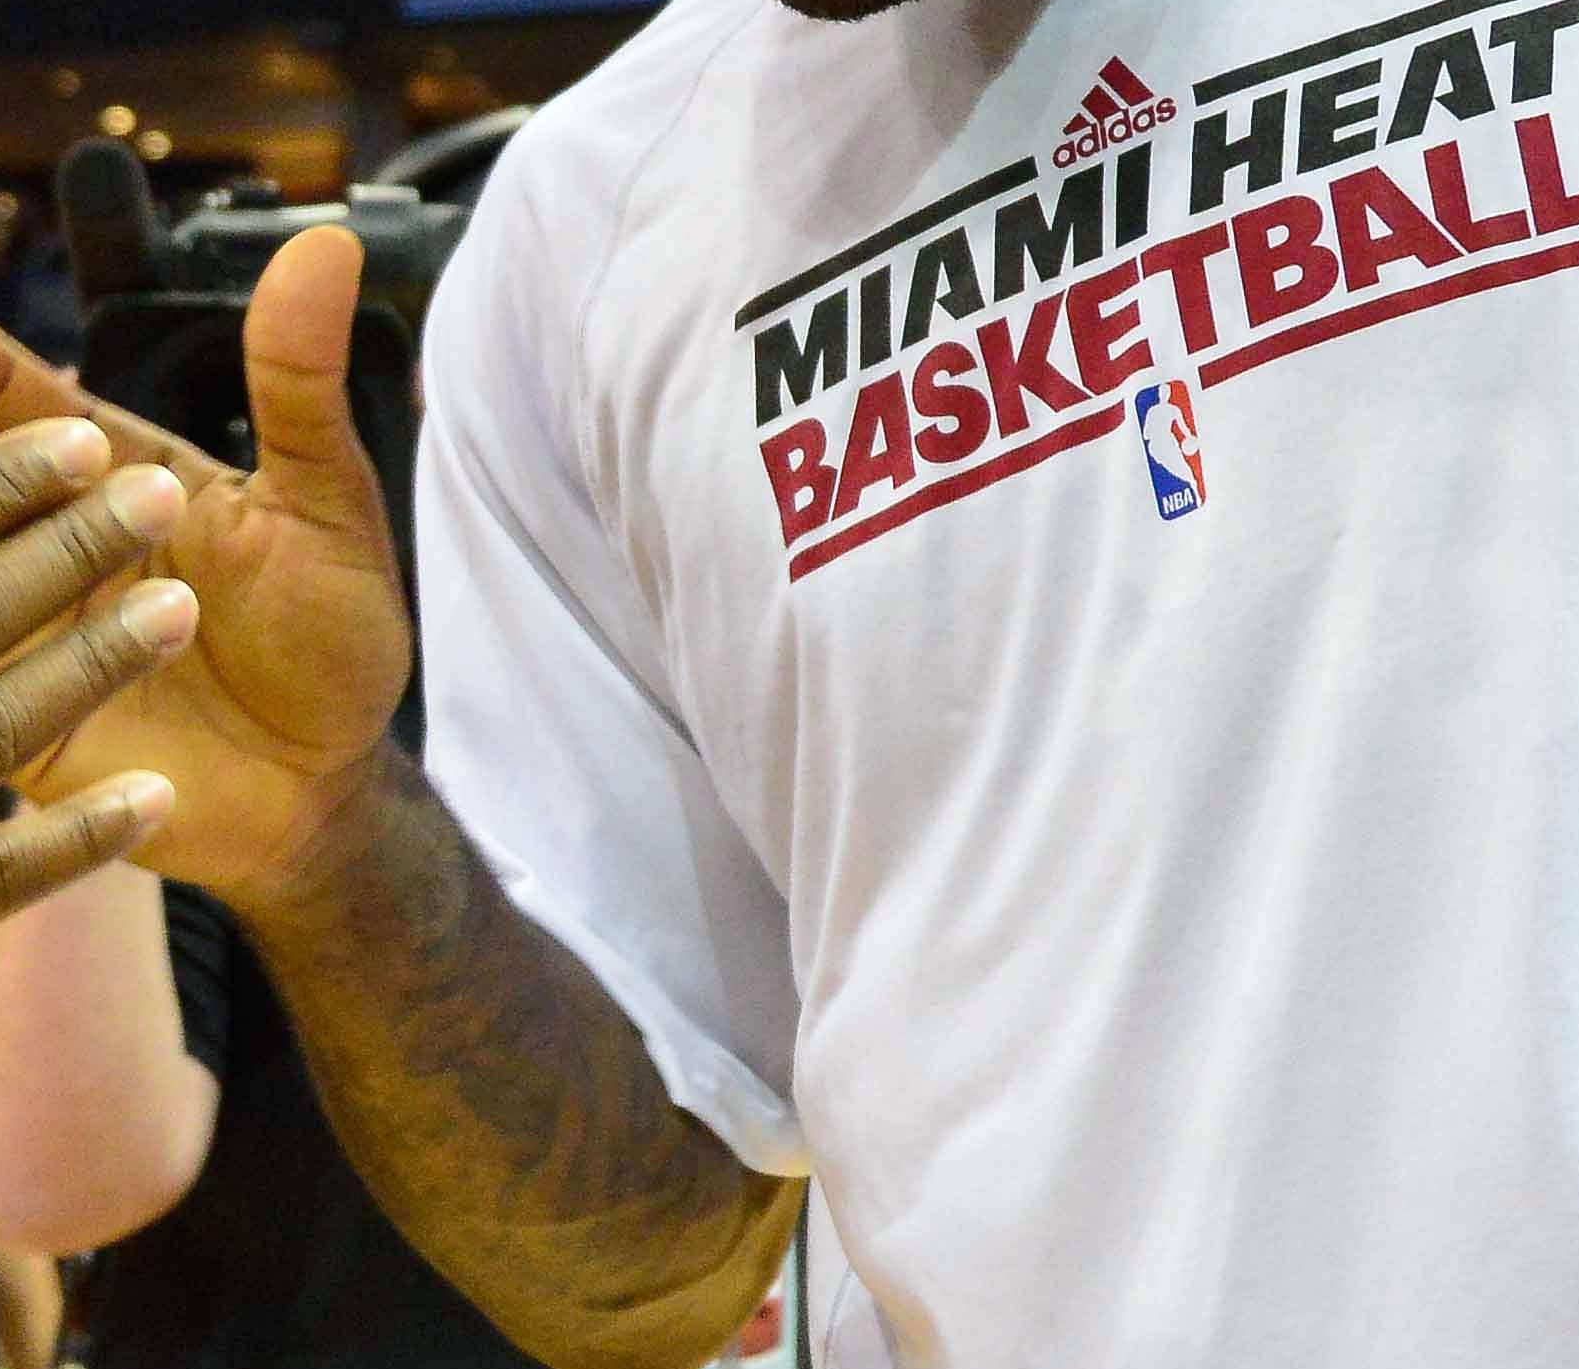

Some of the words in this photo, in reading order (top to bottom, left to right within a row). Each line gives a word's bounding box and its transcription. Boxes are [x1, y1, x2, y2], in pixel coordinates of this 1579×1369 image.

[1051, 94, 1177, 170] adidas
[752, 139, 1152, 429] MIAMI
[1159, 485, 1196, 516] NBA
